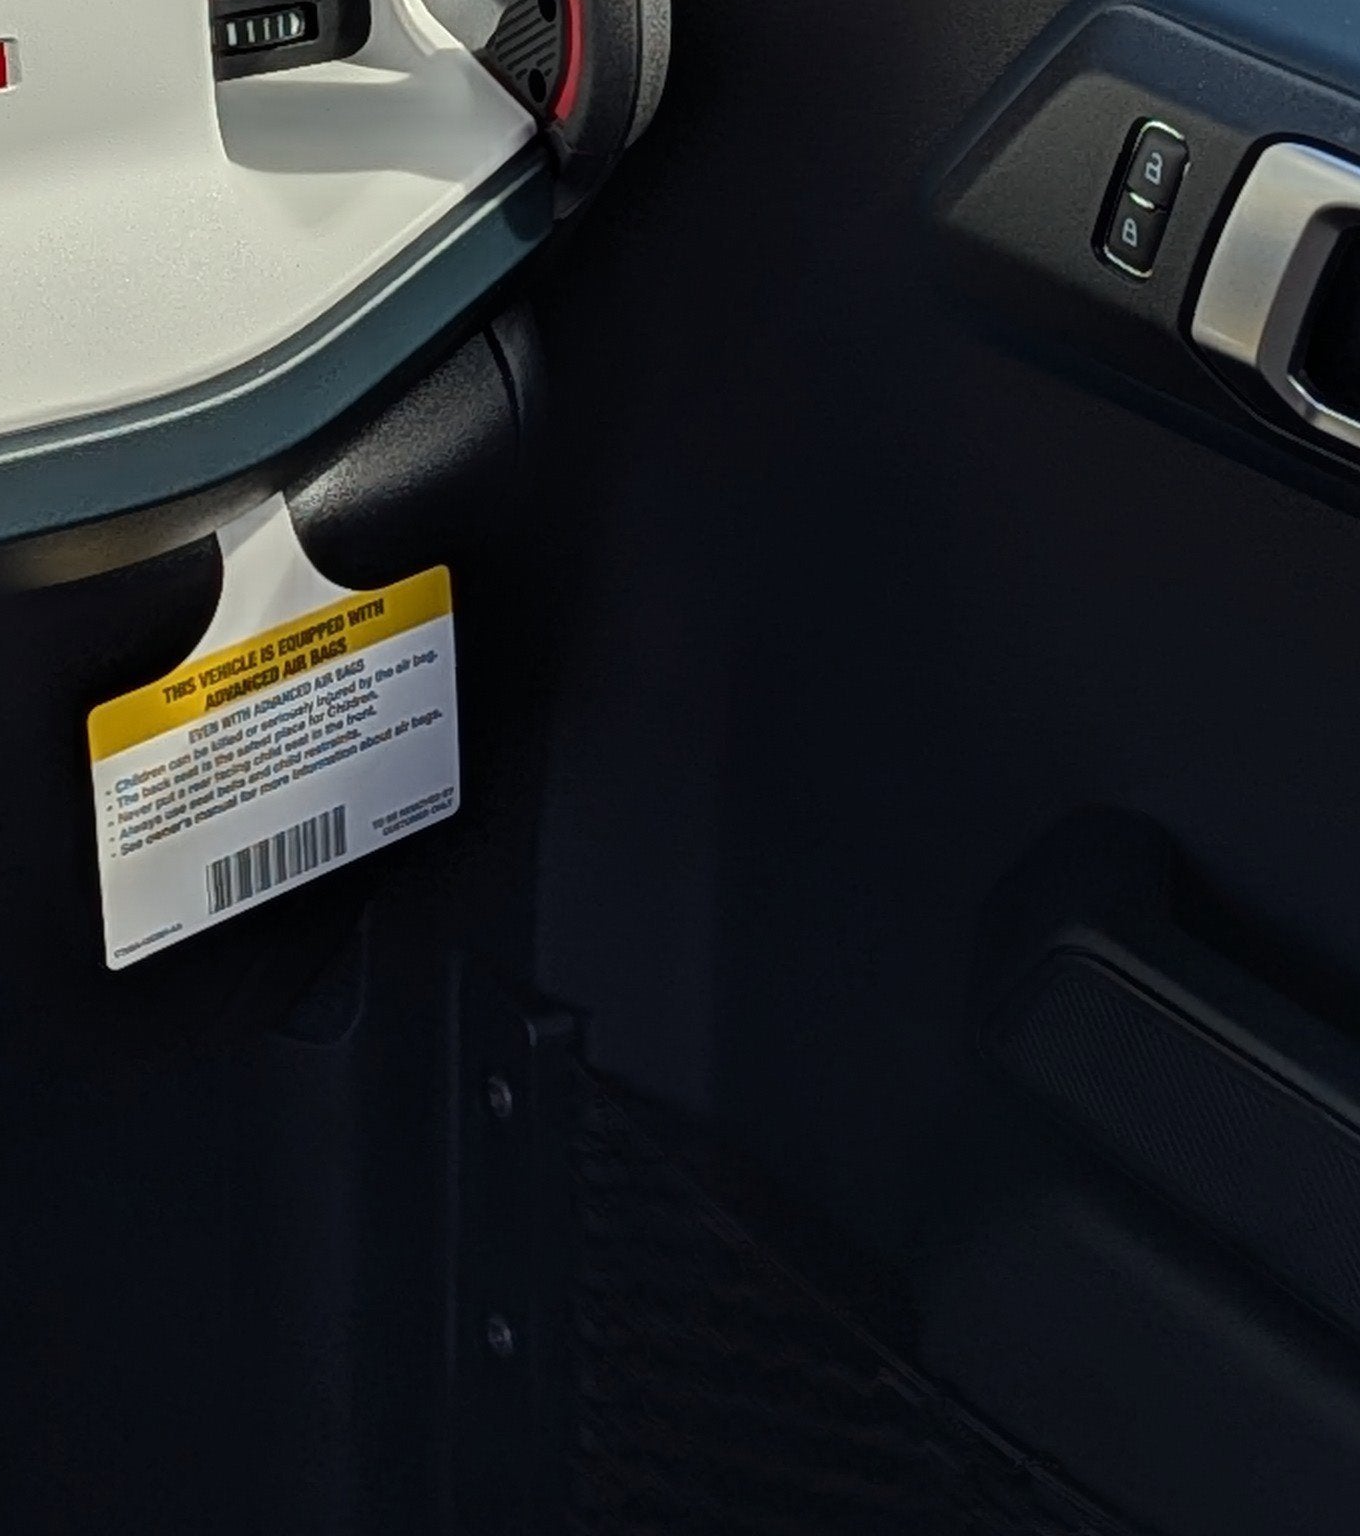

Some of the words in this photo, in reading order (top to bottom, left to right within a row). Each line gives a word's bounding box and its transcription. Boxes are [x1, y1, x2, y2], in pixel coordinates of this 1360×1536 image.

[163, 674, 197, 703] THIS
[200, 650, 257, 688] VEHICLE
[260, 643, 274, 663] IS
[277, 614, 344, 656] EQUIPPED
[347, 598, 384, 628] WITH
[204, 664, 279, 711] ADVANCED
[282, 653, 306, 678] AIR
[310, 636, 346, 667] BAGS
[188, 719, 218, 743] EVEN
[221, 706, 251, 730] WITH
[253, 680, 311, 716] ADVANCED
[314, 671, 333, 691] AIR
[336, 658, 364, 681] BAGS
